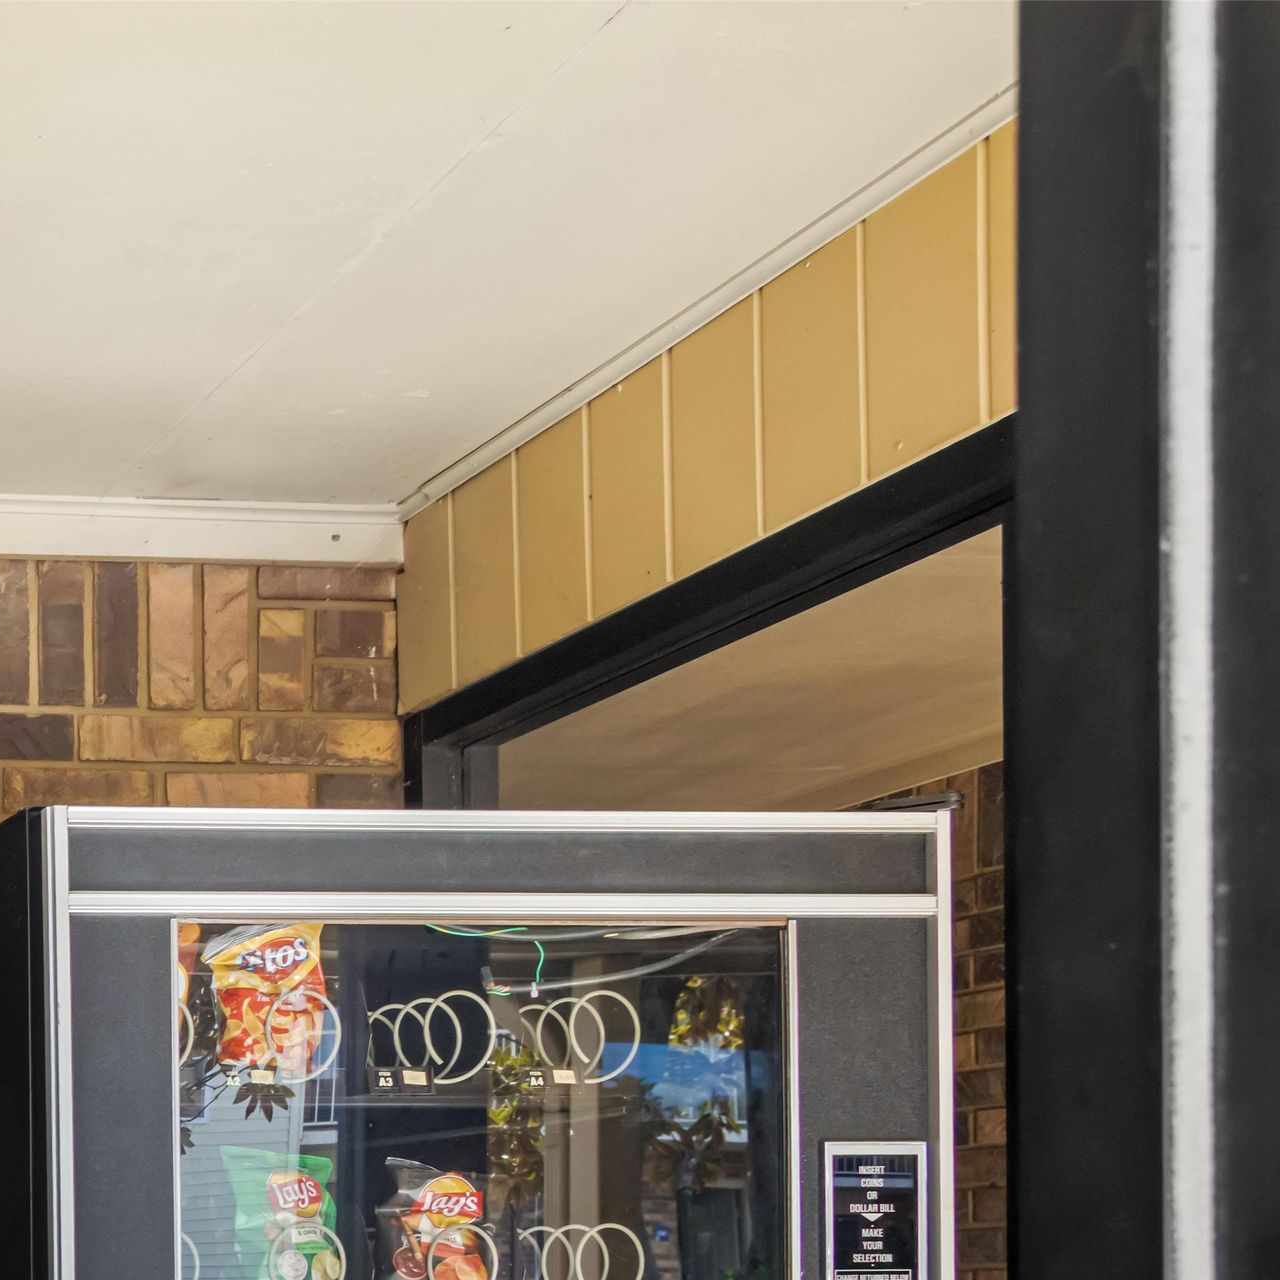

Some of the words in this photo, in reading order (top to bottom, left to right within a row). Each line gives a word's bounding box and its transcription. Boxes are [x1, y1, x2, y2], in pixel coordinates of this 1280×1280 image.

[226, 1077, 240, 1086] A2
[379, 1077, 393, 1087] A3
[530, 1077, 544, 1086] A4
[858, 1166, 886, 1175] INSERT
[860, 1178, 884, 1188] COINS
[272, 1177, 317, 1208] Lay's
[867, 1191, 878, 1200] OR
[421, 1191, 478, 1216] Lay's
[850, 1204, 878, 1213] DOLLAR
[880, 1204, 896, 1213] BILL
[861, 1228, 884, 1238] MAKE
[862, 1241, 883, 1250] YOUR
[852, 1254, 893, 1263] SELECTION
